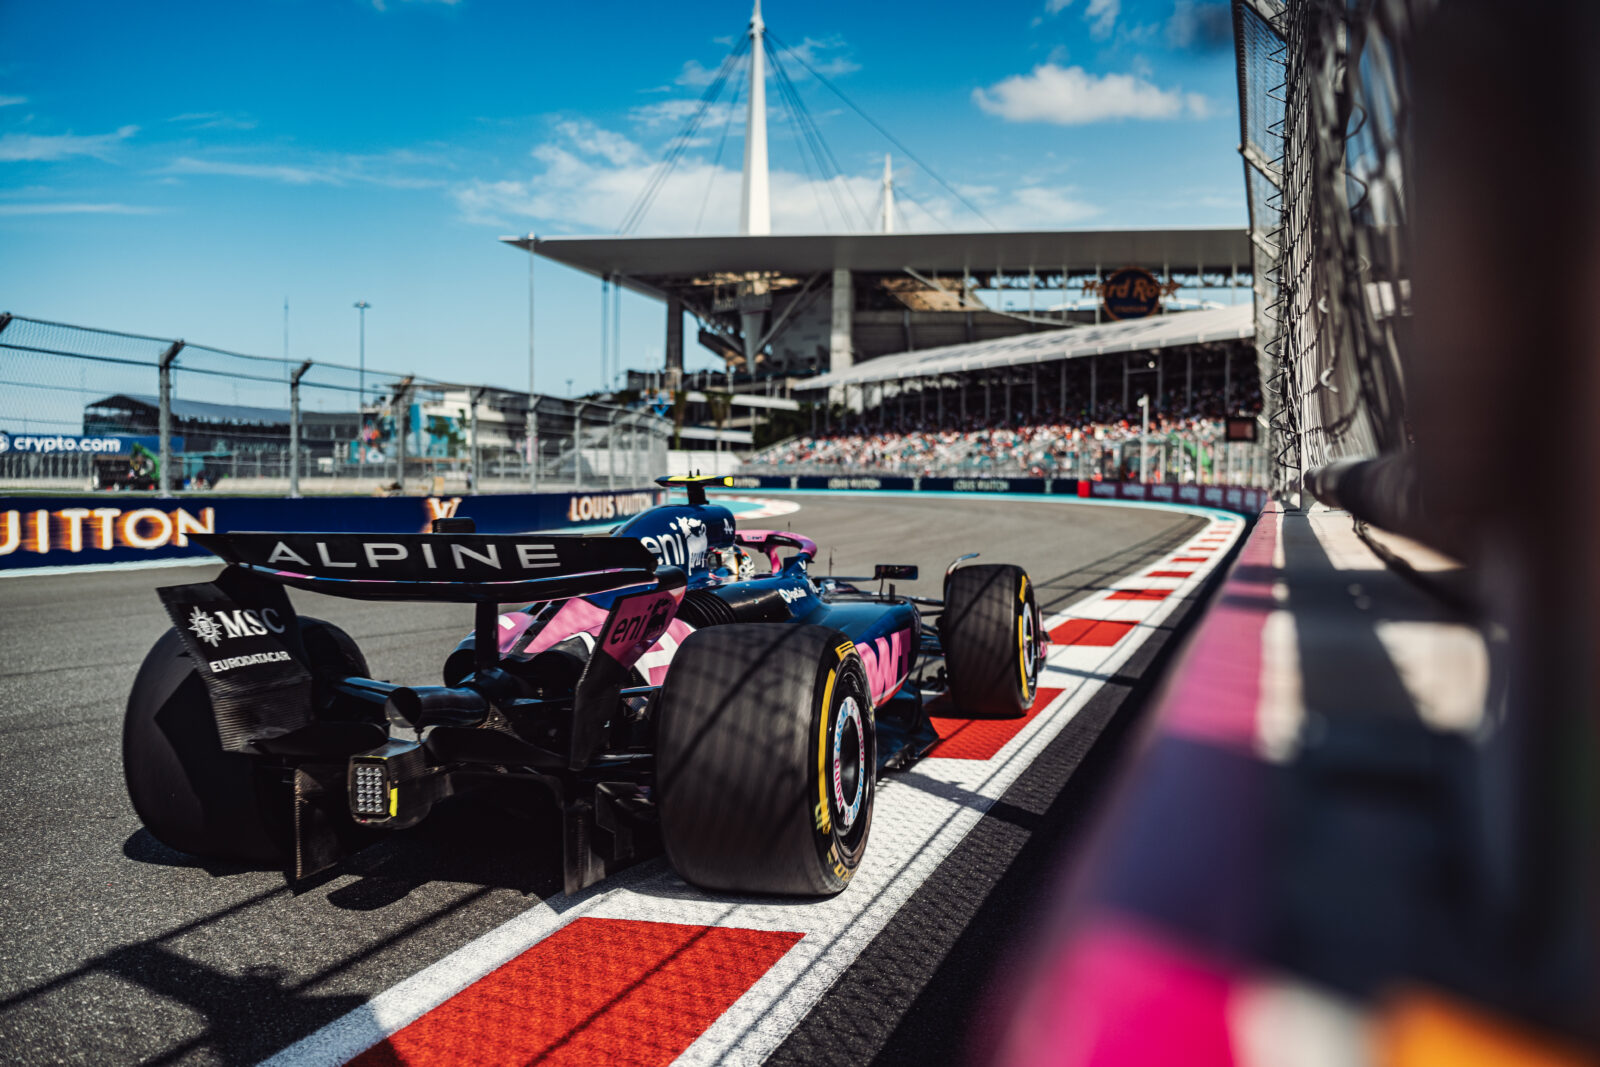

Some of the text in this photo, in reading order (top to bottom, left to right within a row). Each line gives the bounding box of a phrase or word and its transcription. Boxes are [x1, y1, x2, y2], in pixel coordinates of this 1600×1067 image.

[14, 435, 121, 453] crypto.com
[569, 495, 615, 521] LOUIS
[267, 541, 561, 570] ALPINE
[641, 522, 685, 566] eni
[214, 608, 285, 638] MSC
[611, 603, 653, 645] eni
[209, 651, 291, 673] EURODATACAR
